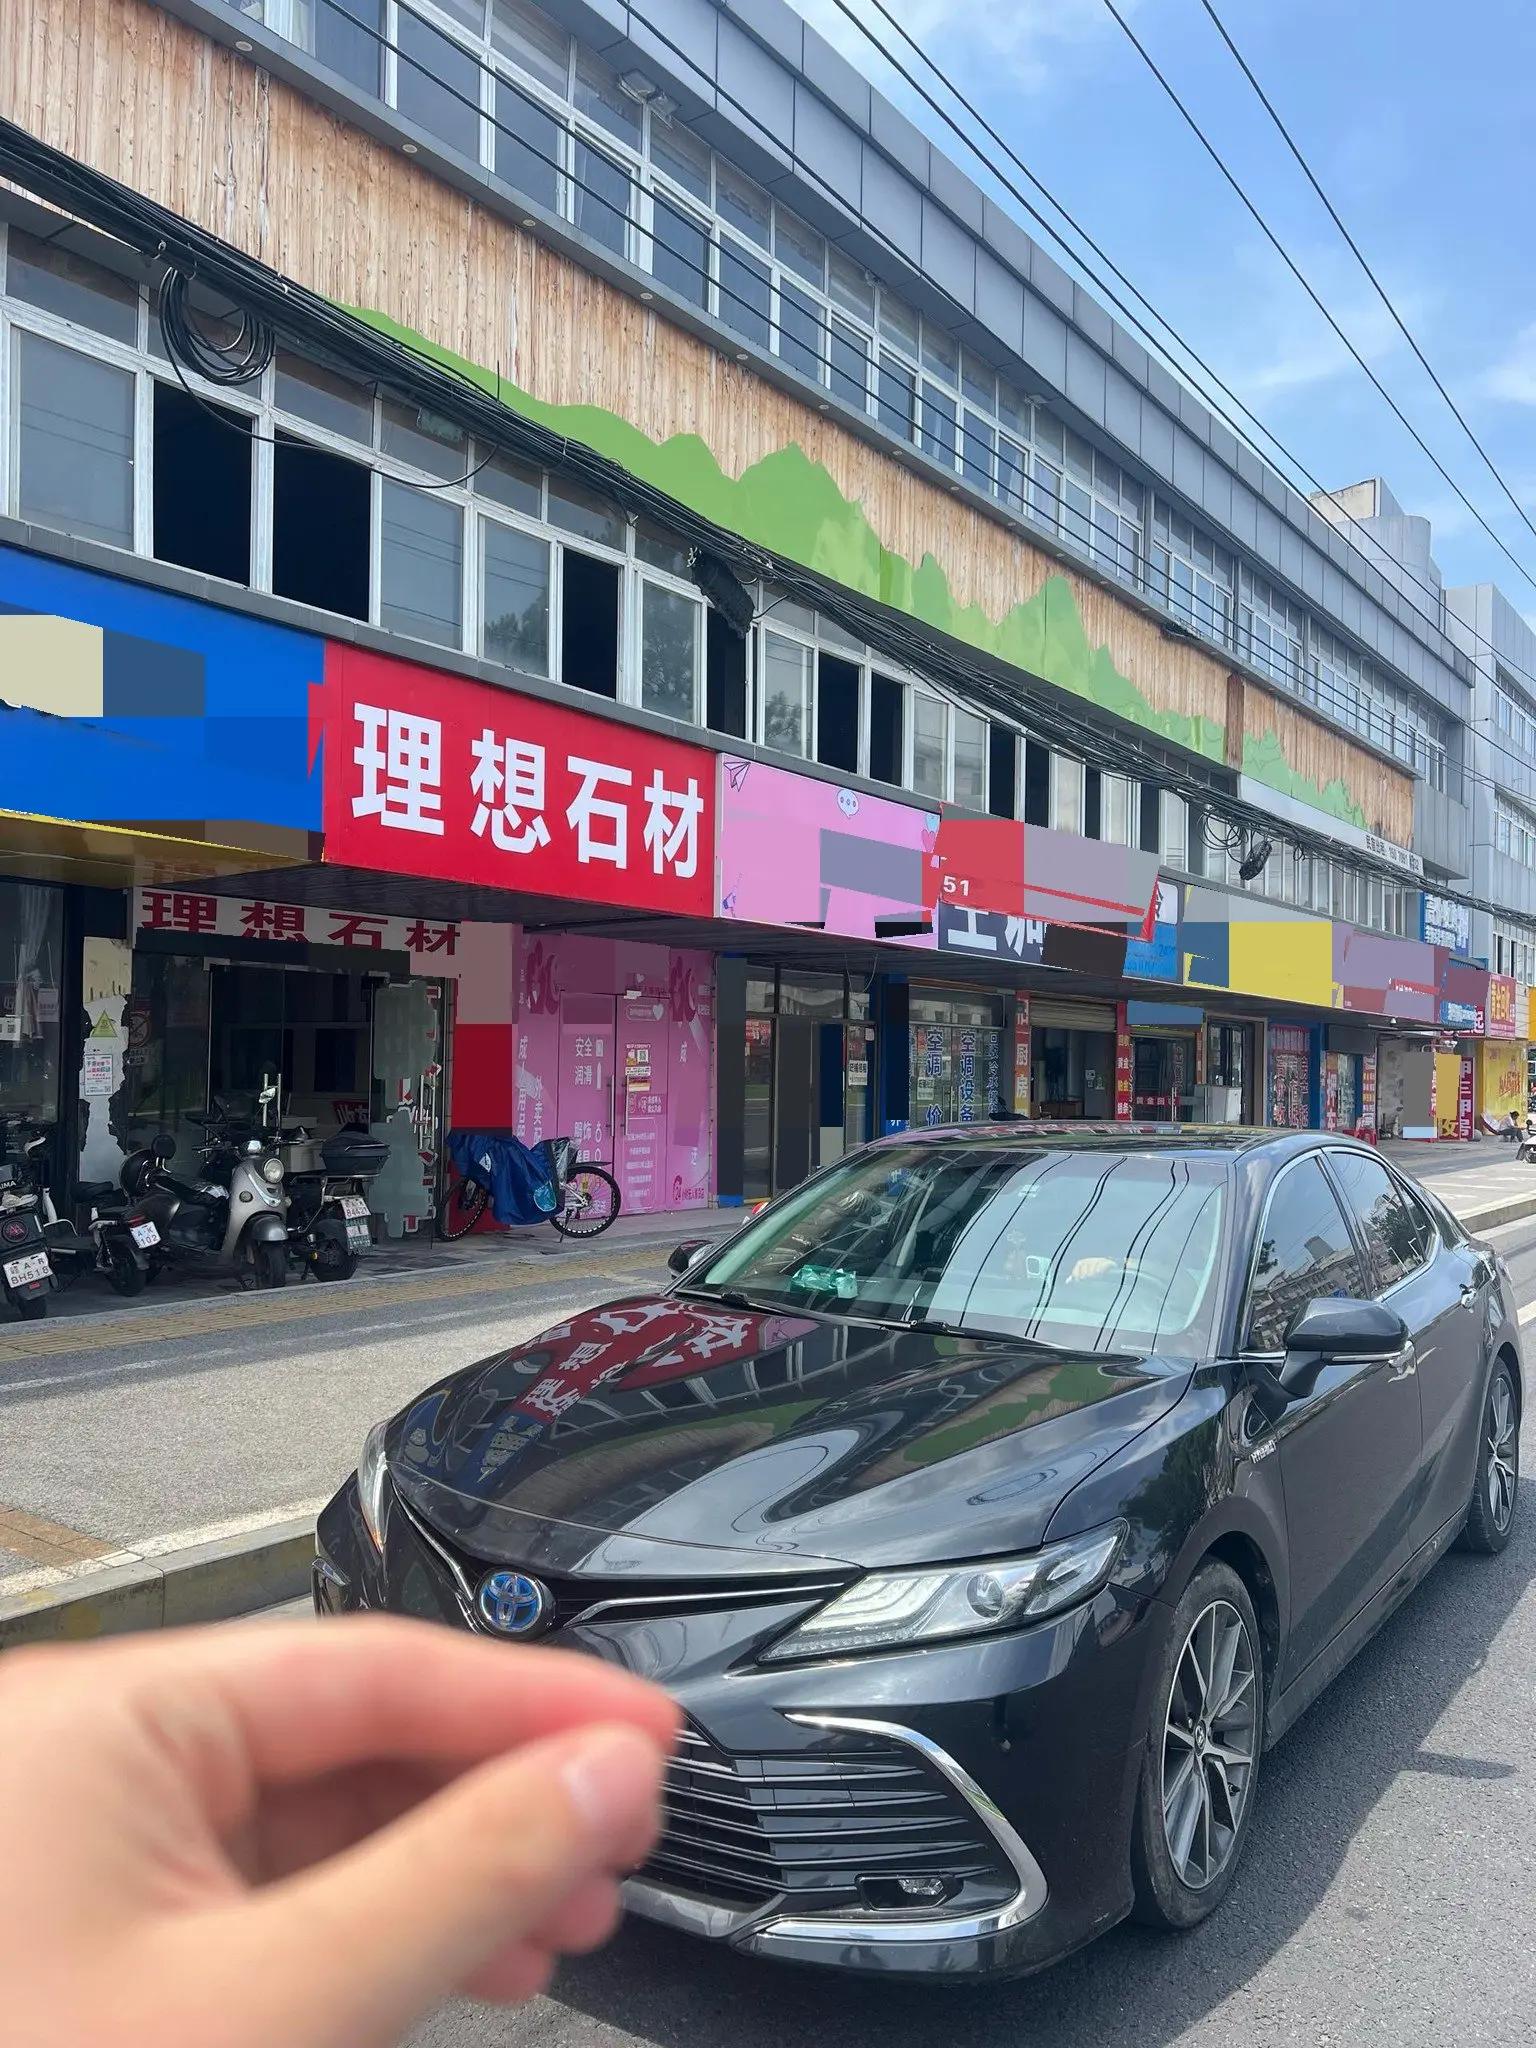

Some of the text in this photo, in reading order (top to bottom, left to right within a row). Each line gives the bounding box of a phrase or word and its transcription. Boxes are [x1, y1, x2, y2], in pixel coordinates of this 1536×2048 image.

[351, 701, 705, 880] 理想石材
[943, 875, 970, 897] 51
[141, 890, 461, 956] 理想石材
[575, 1037, 593, 1058] 安全
[574, 1065, 593, 1086] 润滑
[0, 1180, 17, 1190] IMA
